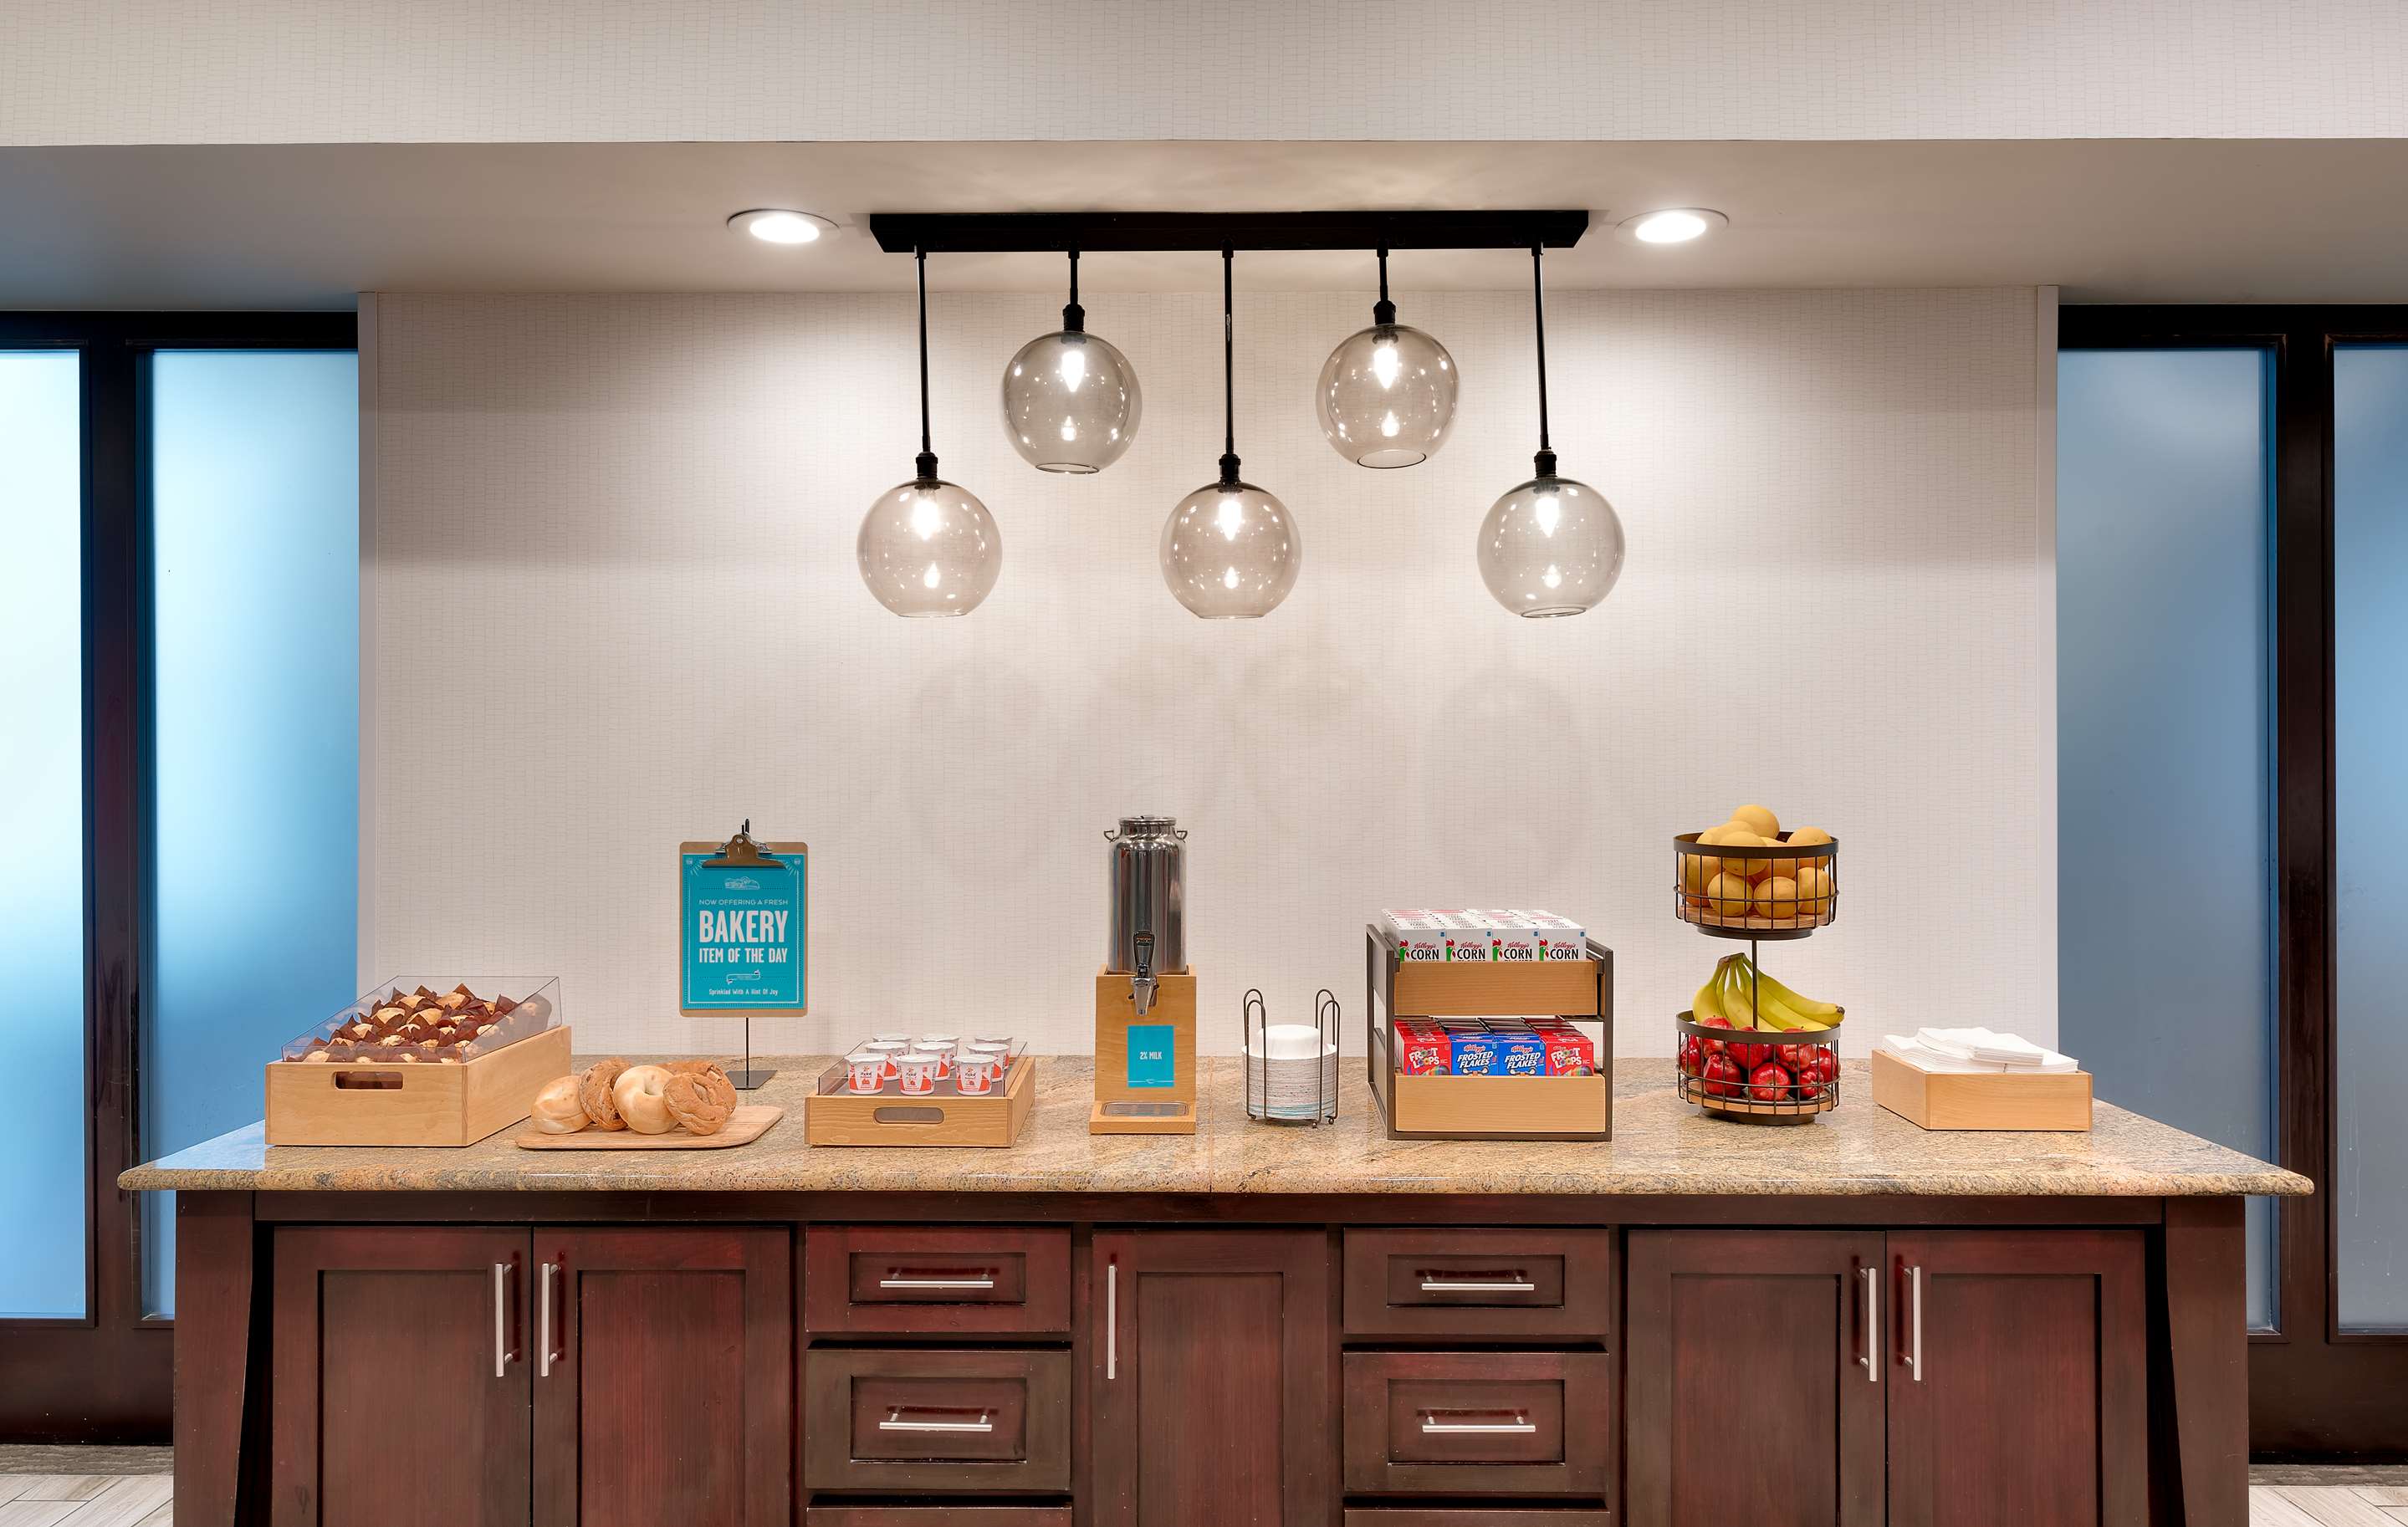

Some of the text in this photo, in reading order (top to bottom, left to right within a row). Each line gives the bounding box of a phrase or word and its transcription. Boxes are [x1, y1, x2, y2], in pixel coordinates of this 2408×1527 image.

[699, 910, 788, 942] BAKERY
[699, 947, 788, 963] ITEM OF THE DAY
[1411, 949, 1439, 960] CORN
[1457, 948, 1485, 959] CORN
[1504, 948, 1532, 959] CORN
[1550, 948, 1579, 959] CORN
[1148, 1051, 1163, 1060] MILK
[1409, 1047, 1438, 1062] FROOT
[1457, 1051, 1494, 1062] FROSTED
[1505, 1052, 1541, 1063] FROSTED
[1551, 1047, 1580, 1062] FROOT
[1413, 1056, 1439, 1069] LOOPS
[1460, 1059, 1490, 1069] FLAKES
[1506, 1060, 1537, 1070] FLAKES
[1554, 1056, 1582, 1069] LOOPS
